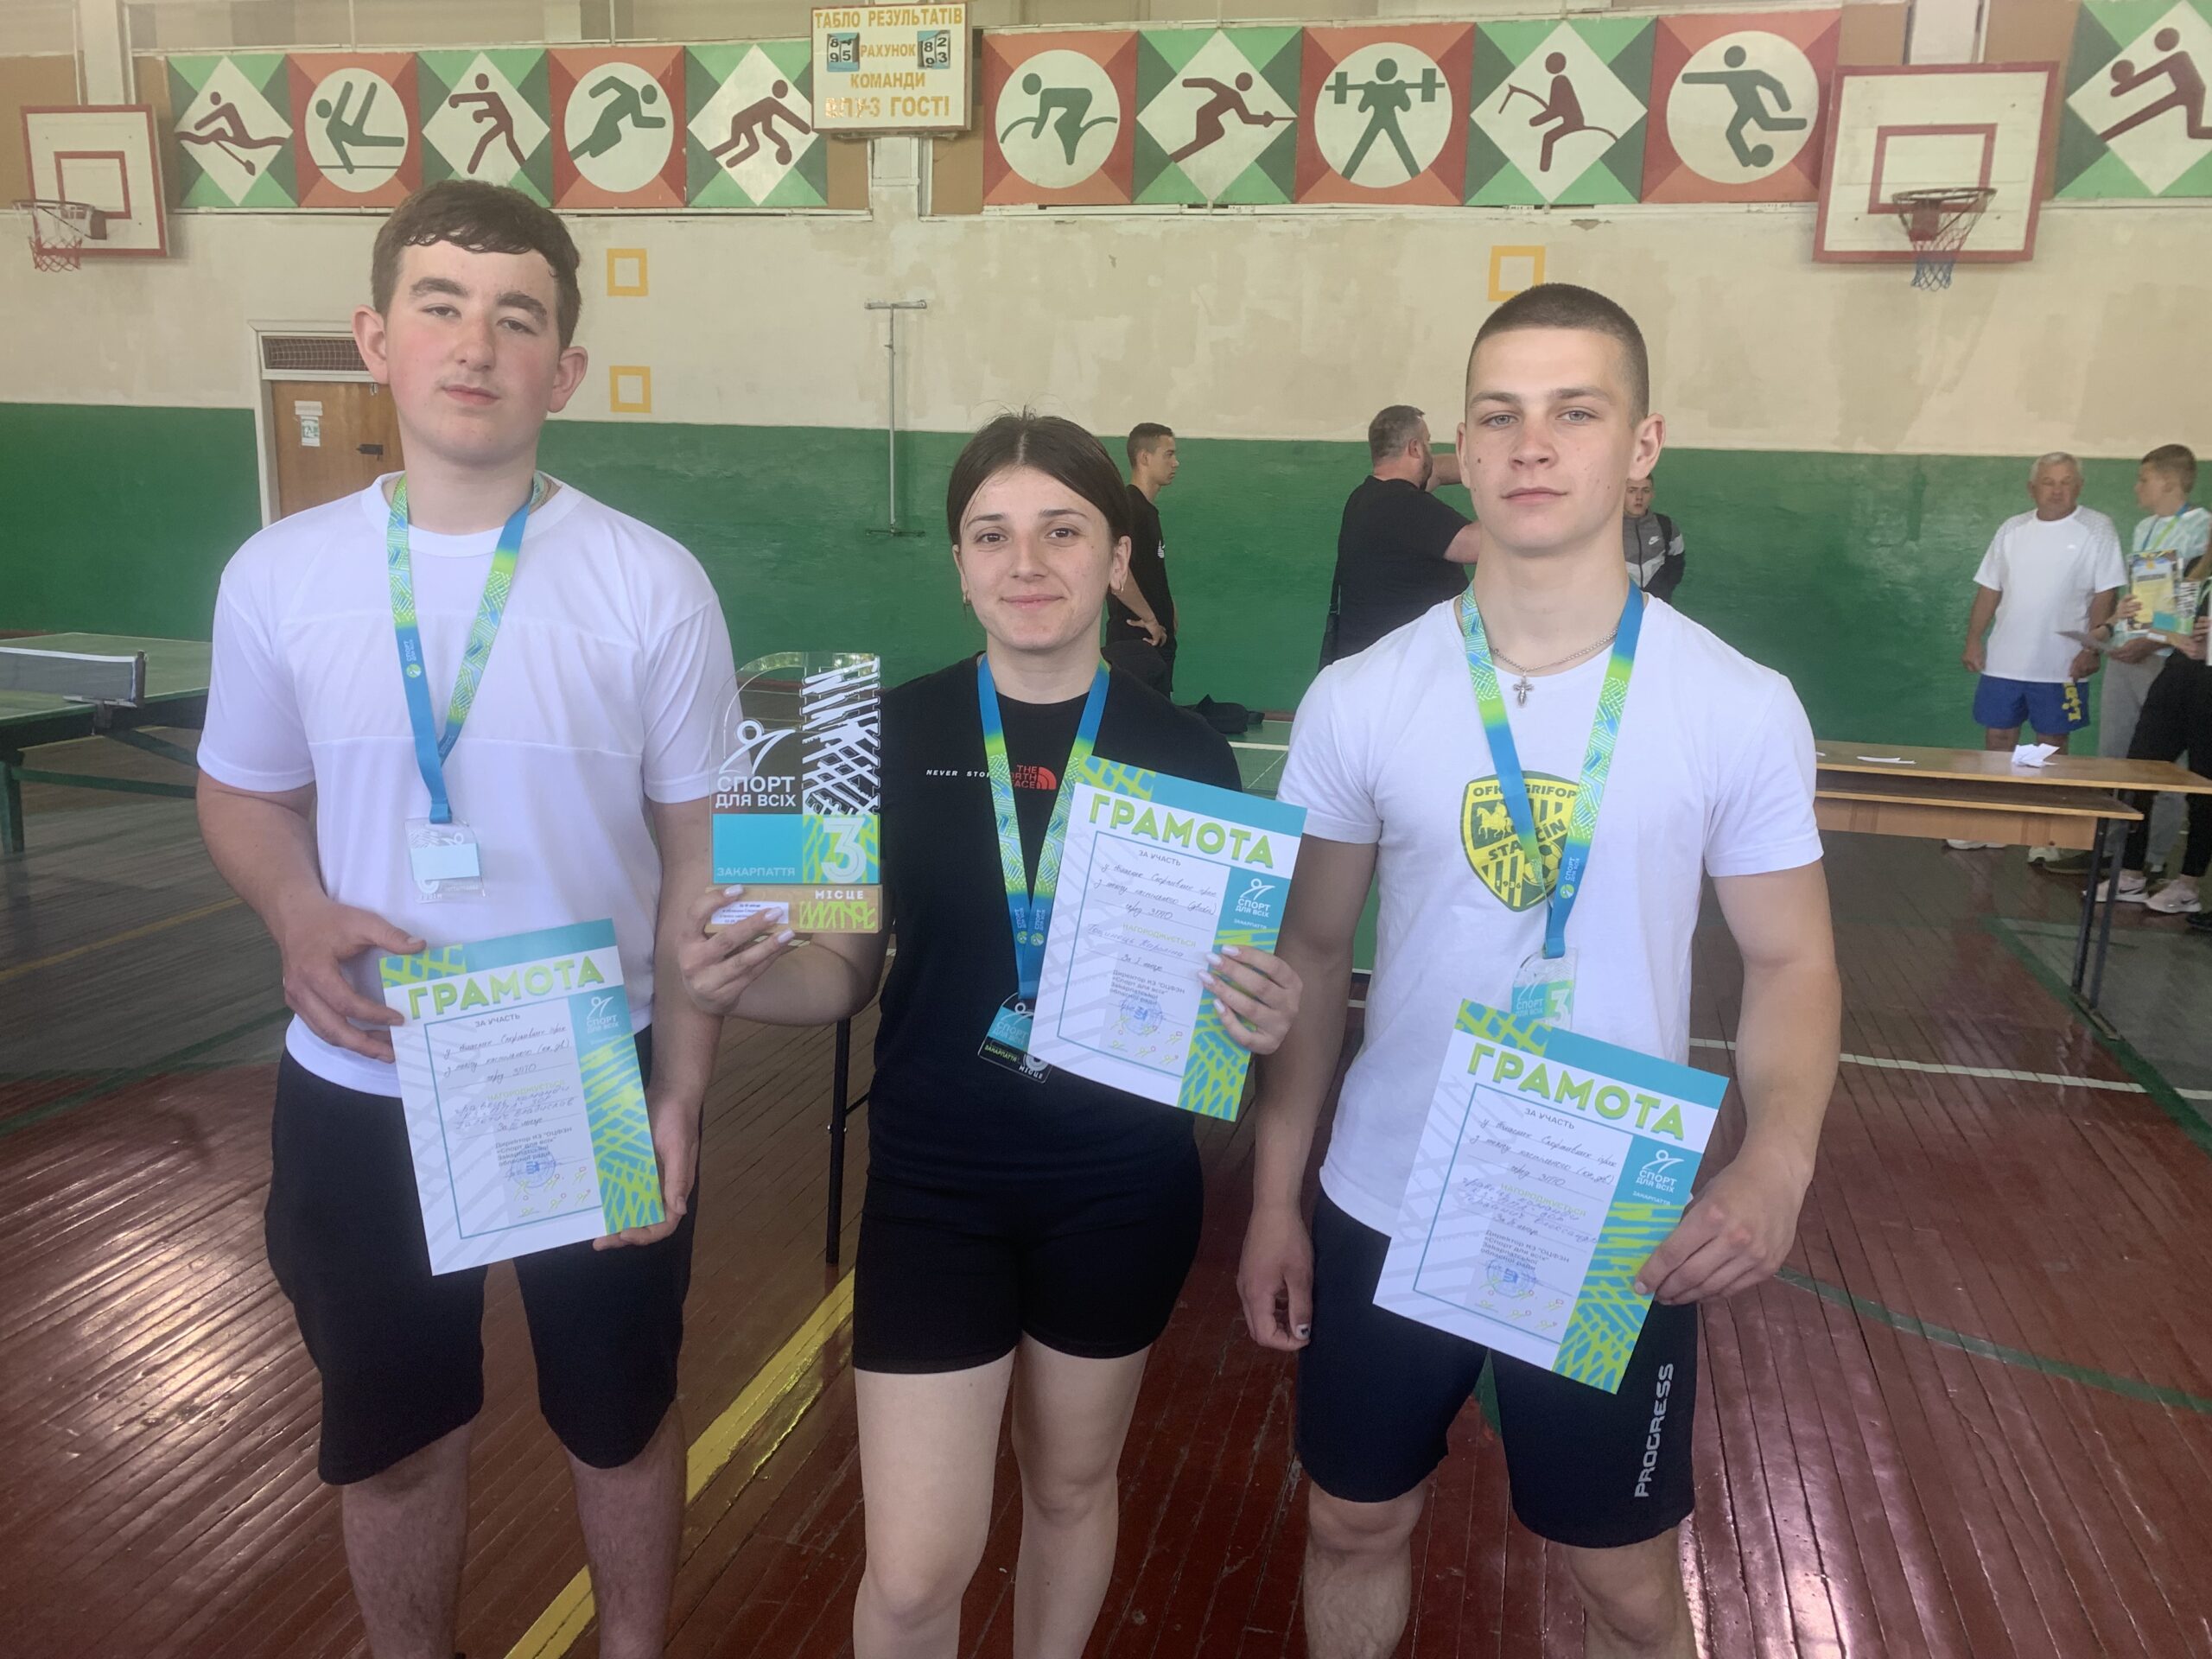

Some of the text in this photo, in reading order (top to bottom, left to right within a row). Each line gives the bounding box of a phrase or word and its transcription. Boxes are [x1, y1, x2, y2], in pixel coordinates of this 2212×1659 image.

[815, 8, 963, 29] ТАБЛО РЕЗУЛЬТАТІВ
[860, 44, 916, 58] РАХУНОК
[850, 72, 925, 90] КОМАНДИ
[890, 96, 950, 117] ГОСТІ
[1017, 765, 1038, 773] THE
[717, 775, 796, 794] СПОРТ
[715, 794, 797, 808] ДЛЯ ВСІХ
[1089, 792, 1274, 869] ГРАМОТА
[822, 817, 867, 884] 3
[1139, 849, 1182, 867] ЗА УЧАСТЬ
[717, 867, 796, 878] ЗАКАРПАТТЯ
[815, 890, 865, 899] МІСЦЕ
[1237, 899, 1271, 912] СПОРТ
[408, 956, 605, 1020] ГРАМОТА
[1516, 998, 1543, 1010] СПОРТ
[475, 1014, 520, 1028] ЗА УЧАСТЬ
[1467, 1042, 1685, 1141] ГРАМОТА
[1524, 1108, 1575, 1130] ЗА УЧАСТЬ
[1636, 1177, 1675, 1193] ДЛЯ ВСІХ
[1639, 1169, 1678, 1186] СПОРТ
[1634, 1363, 1675, 1498] PROGRESS
